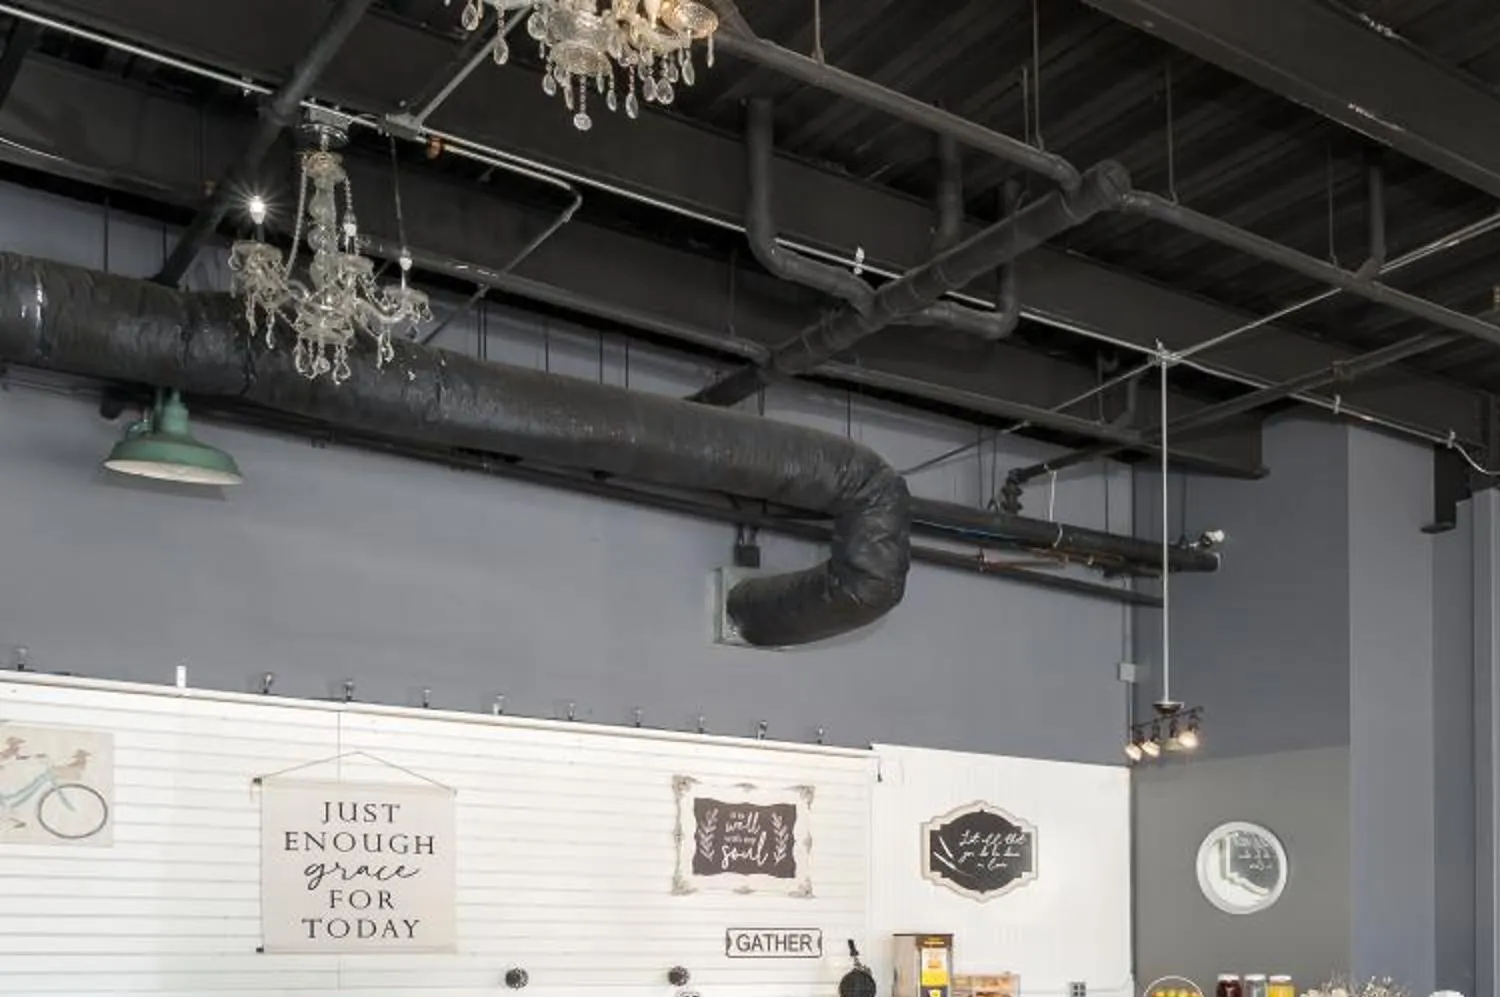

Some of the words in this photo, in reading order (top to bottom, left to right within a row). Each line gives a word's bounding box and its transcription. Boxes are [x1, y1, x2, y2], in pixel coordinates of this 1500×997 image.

[322, 801, 400, 824] JUST
[284, 831, 435, 855] ENOUGH
[303, 861, 421, 890] grace
[329, 889, 395, 910] FOR
[301, 917, 420, 939] TODAY
[736, 933, 812, 952] GATHER
